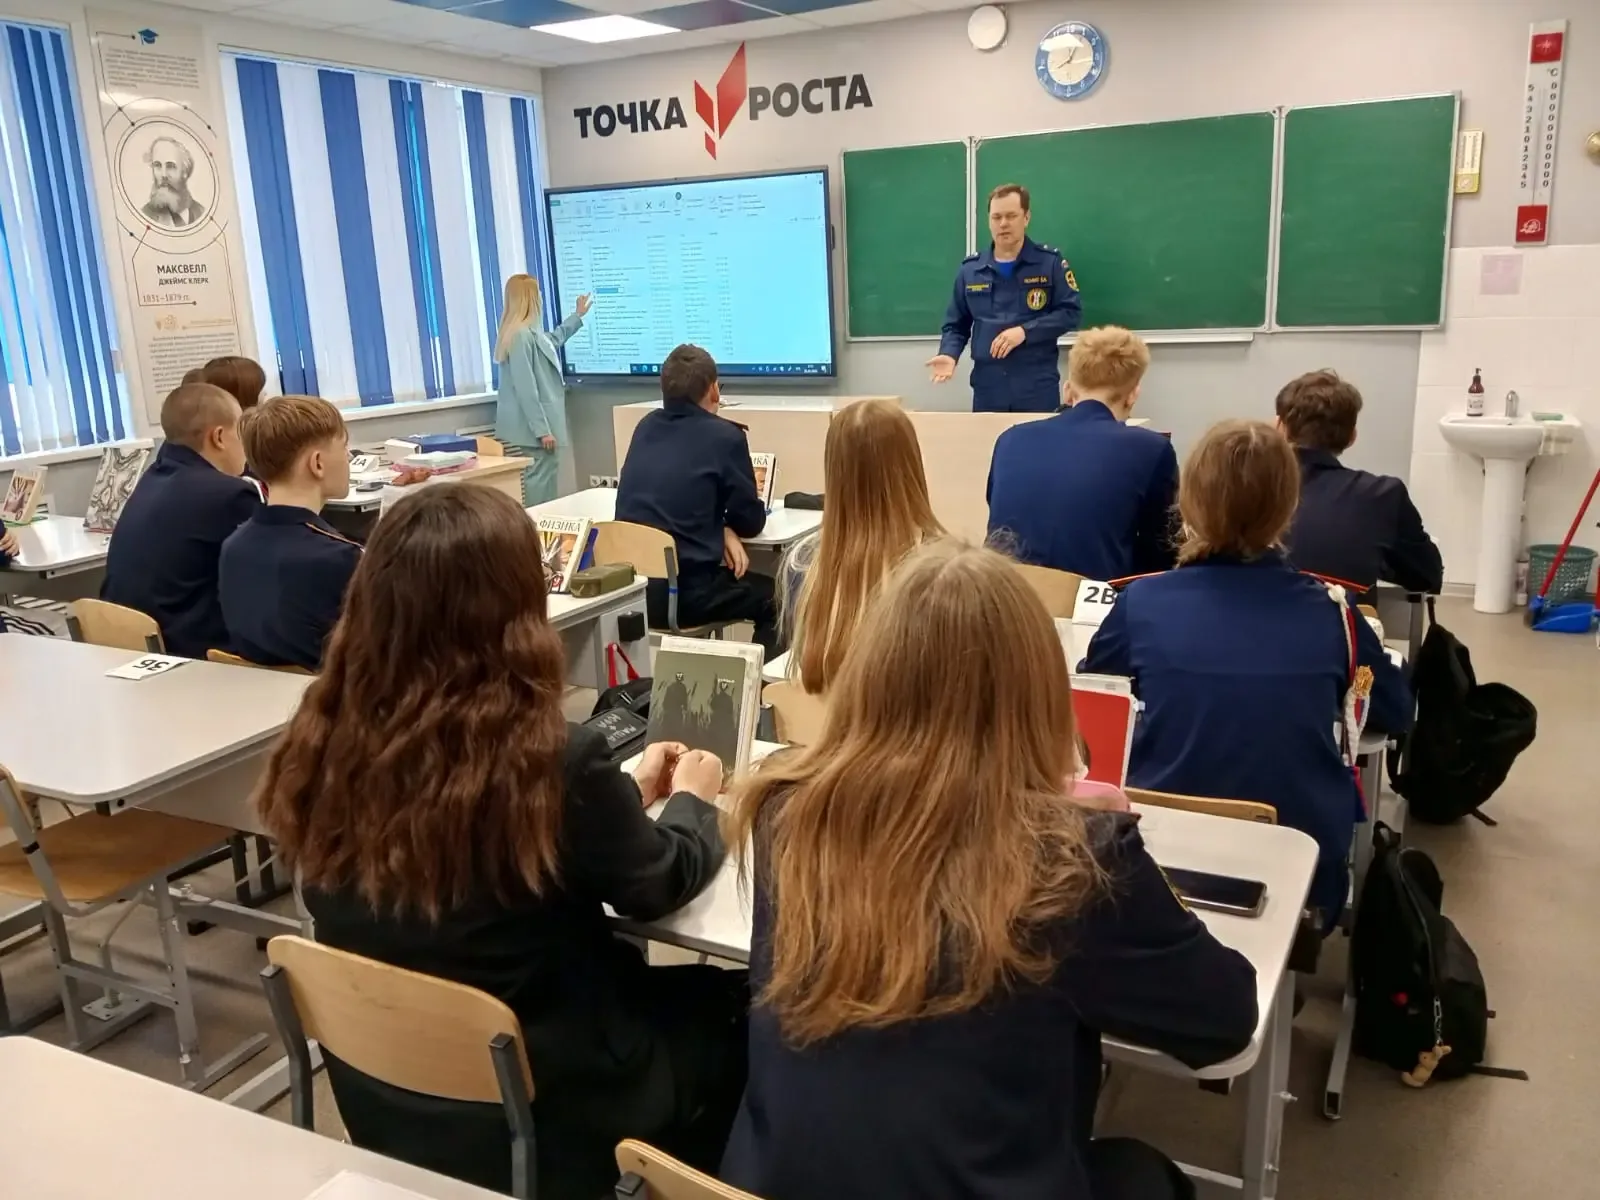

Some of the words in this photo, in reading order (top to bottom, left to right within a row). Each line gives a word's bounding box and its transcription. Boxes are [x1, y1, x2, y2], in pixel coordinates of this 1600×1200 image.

[573, 96, 688, 138] ТОЧКА
[748, 73, 873, 121] РОСТА
[156, 263, 207, 274] МАКСВЕЛЛ
[158, 276, 187, 287] ДЖЕЙМС
[188, 277, 209, 285] КЛЕРК
[540, 519, 580, 532] ФИЗИКА
